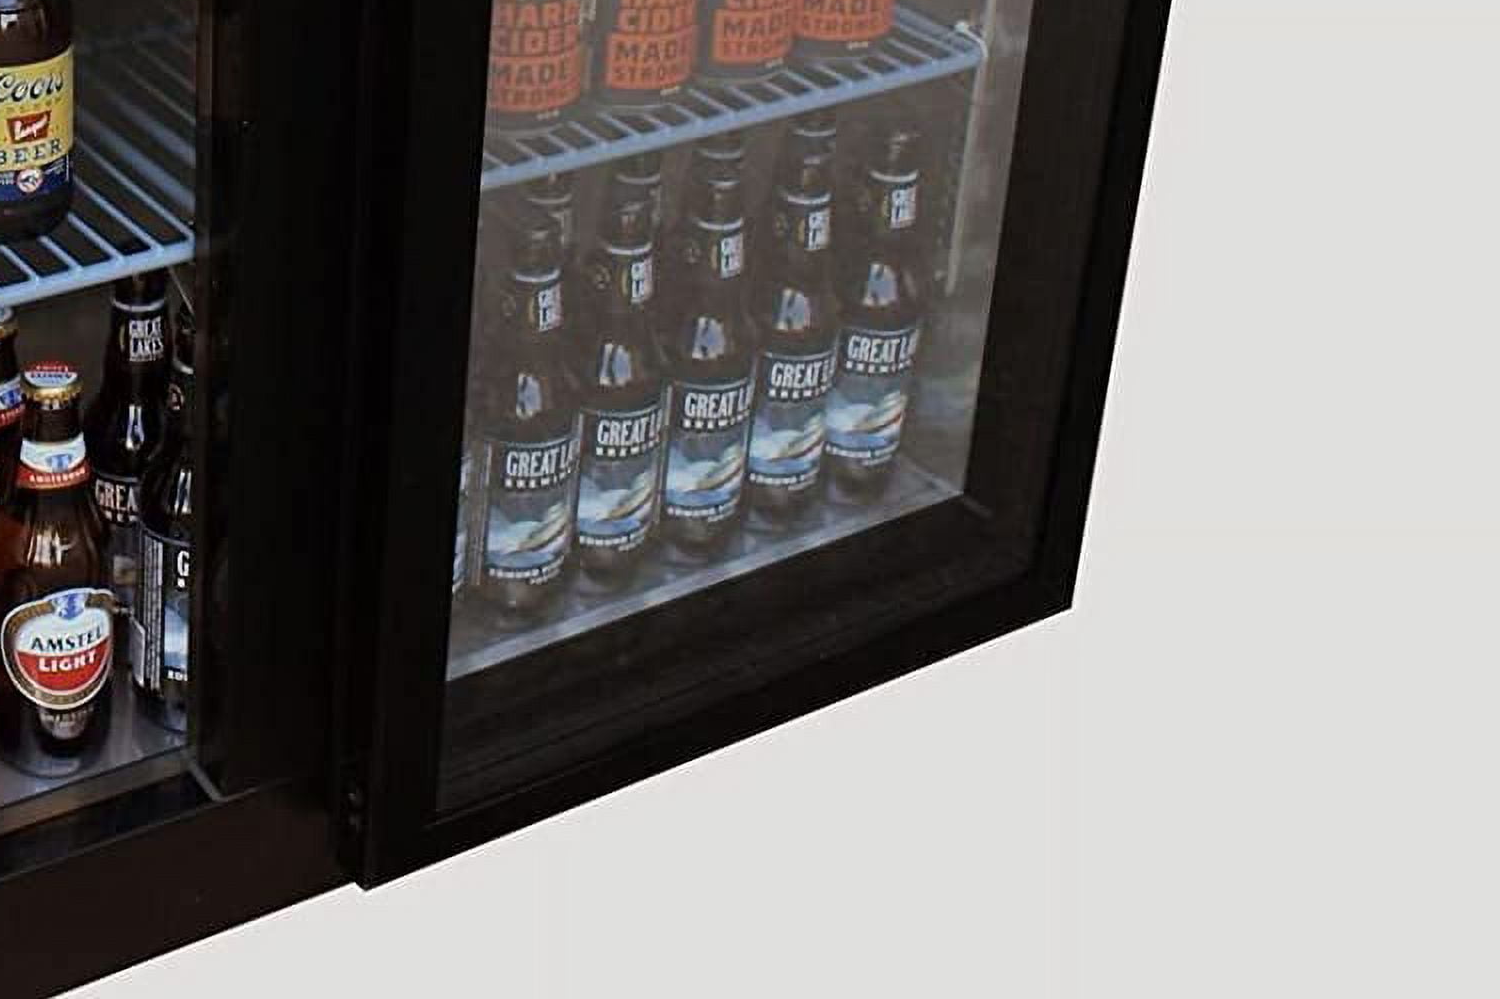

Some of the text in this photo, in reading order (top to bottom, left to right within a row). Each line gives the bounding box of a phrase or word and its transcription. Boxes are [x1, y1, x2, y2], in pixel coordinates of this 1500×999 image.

[848, 335, 900, 362] GREAT
[771, 361, 822, 388] GREAT
[684, 389, 739, 417] GREAT
[597, 417, 650, 445] GREAT
[506, 446, 560, 476] GREAT
[95, 478, 140, 512] GREA
[31, 626, 100, 652] AMSTEL
[38, 650, 97, 673] LIGHT
